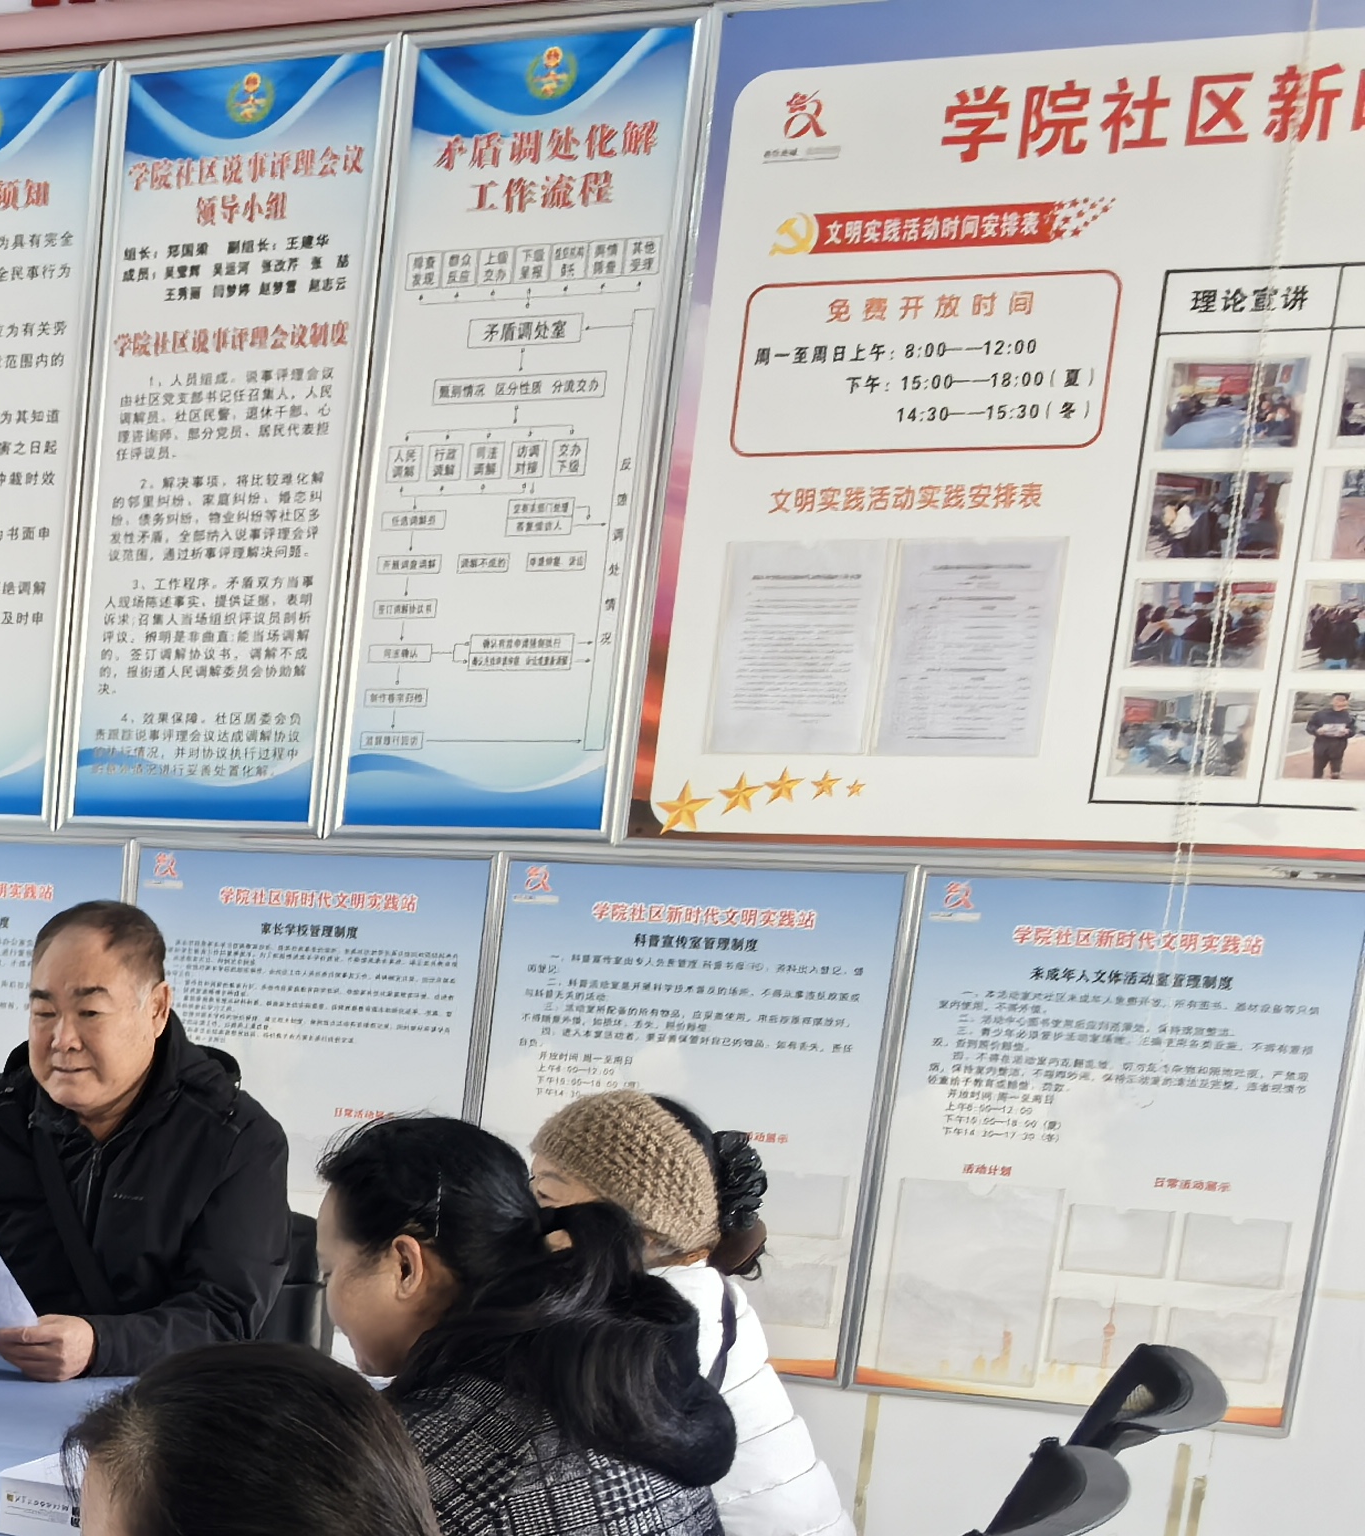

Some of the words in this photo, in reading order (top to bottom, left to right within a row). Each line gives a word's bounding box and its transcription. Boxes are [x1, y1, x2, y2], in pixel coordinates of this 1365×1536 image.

[941, 62, 1365, 163] 学院社区新
[433, 120, 659, 171] 矛盾调处化解
[128, 144, 365, 191] 学院社区说事评理会议
[466, 170, 614, 214] 工作流程
[196, 191, 288, 226] 领导小组
[823, 210, 1041, 246] 文明实践活动时间安排表
[825, 290, 1035, 325] 免费开放时间
[1190, 285, 1309, 315] 理论宣讲
[113, 320, 350, 358] 学院社区说事评理会议制度
[481, 319, 568, 343] 矛盾调处室
[551, 377, 600, 394] 分流交办
[394, 449, 417, 464] 人民
[434, 447, 457, 461] 行政
[391, 464, 415, 479] 调解
[432, 462, 456, 477] 调解
[473, 461, 497, 476] 调解
[768, 481, 1044, 514] 文明实践活动实践安排表
[219, 886, 419, 913] 学院社区新时代文明实践站
[591, 901, 819, 931] 学院社区新时代文明实践站
[260, 922, 359, 940] 家长学校管理制度
[633, 933, 760, 953] 科普宣传室管理制度
[1013, 924, 1264, 957] 学院社区新时代文明实践站
[1029, 965, 1235, 991] 未成年人文体活动室管理制度
[334, 1107, 394, 1119] 日常活动展
[962, 1163, 1012, 1178] 活动计划
[1153, 1177, 1232, 1193] 日常活动展示
